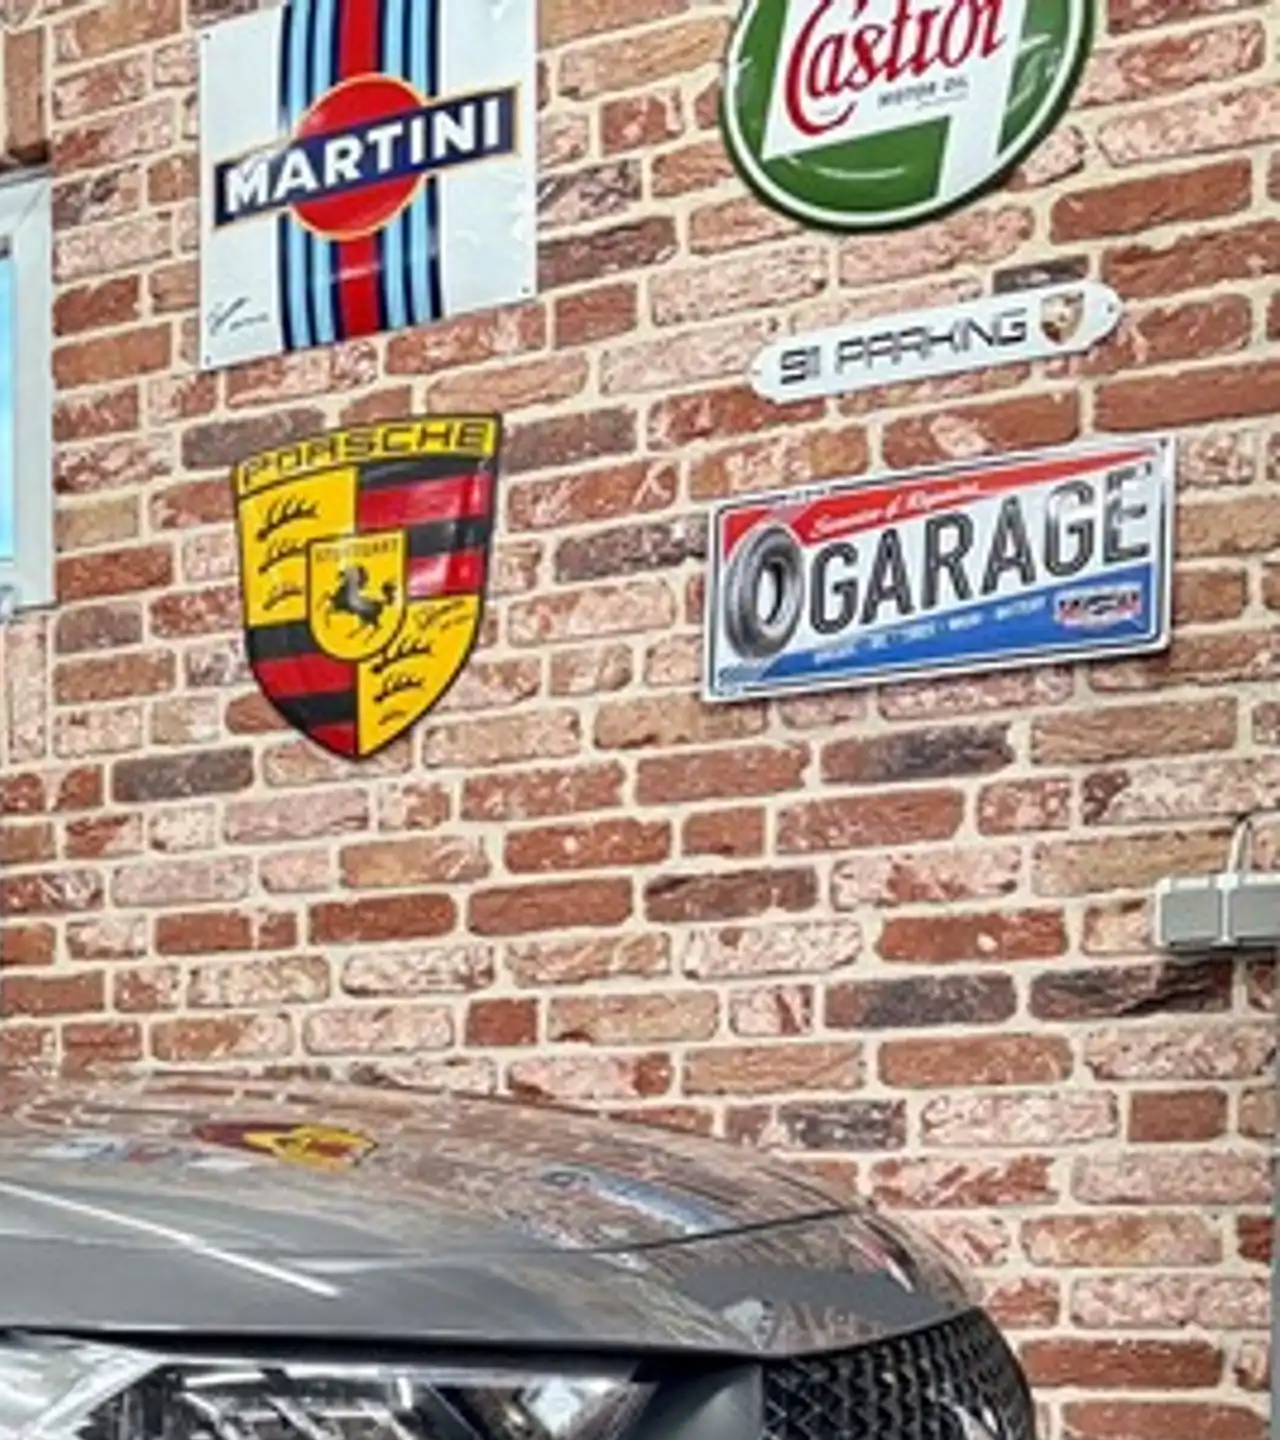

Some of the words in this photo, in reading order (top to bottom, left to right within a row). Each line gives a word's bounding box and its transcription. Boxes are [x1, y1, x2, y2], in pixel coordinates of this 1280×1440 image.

[785, 0, 1008, 136] Castrol
[226, 98, 501, 213] MARTINI
[835, 306, 1028, 374] PARKING
[242, 421, 489, 483] PORSCHE
[808, 463, 1153, 635] GARAGE
